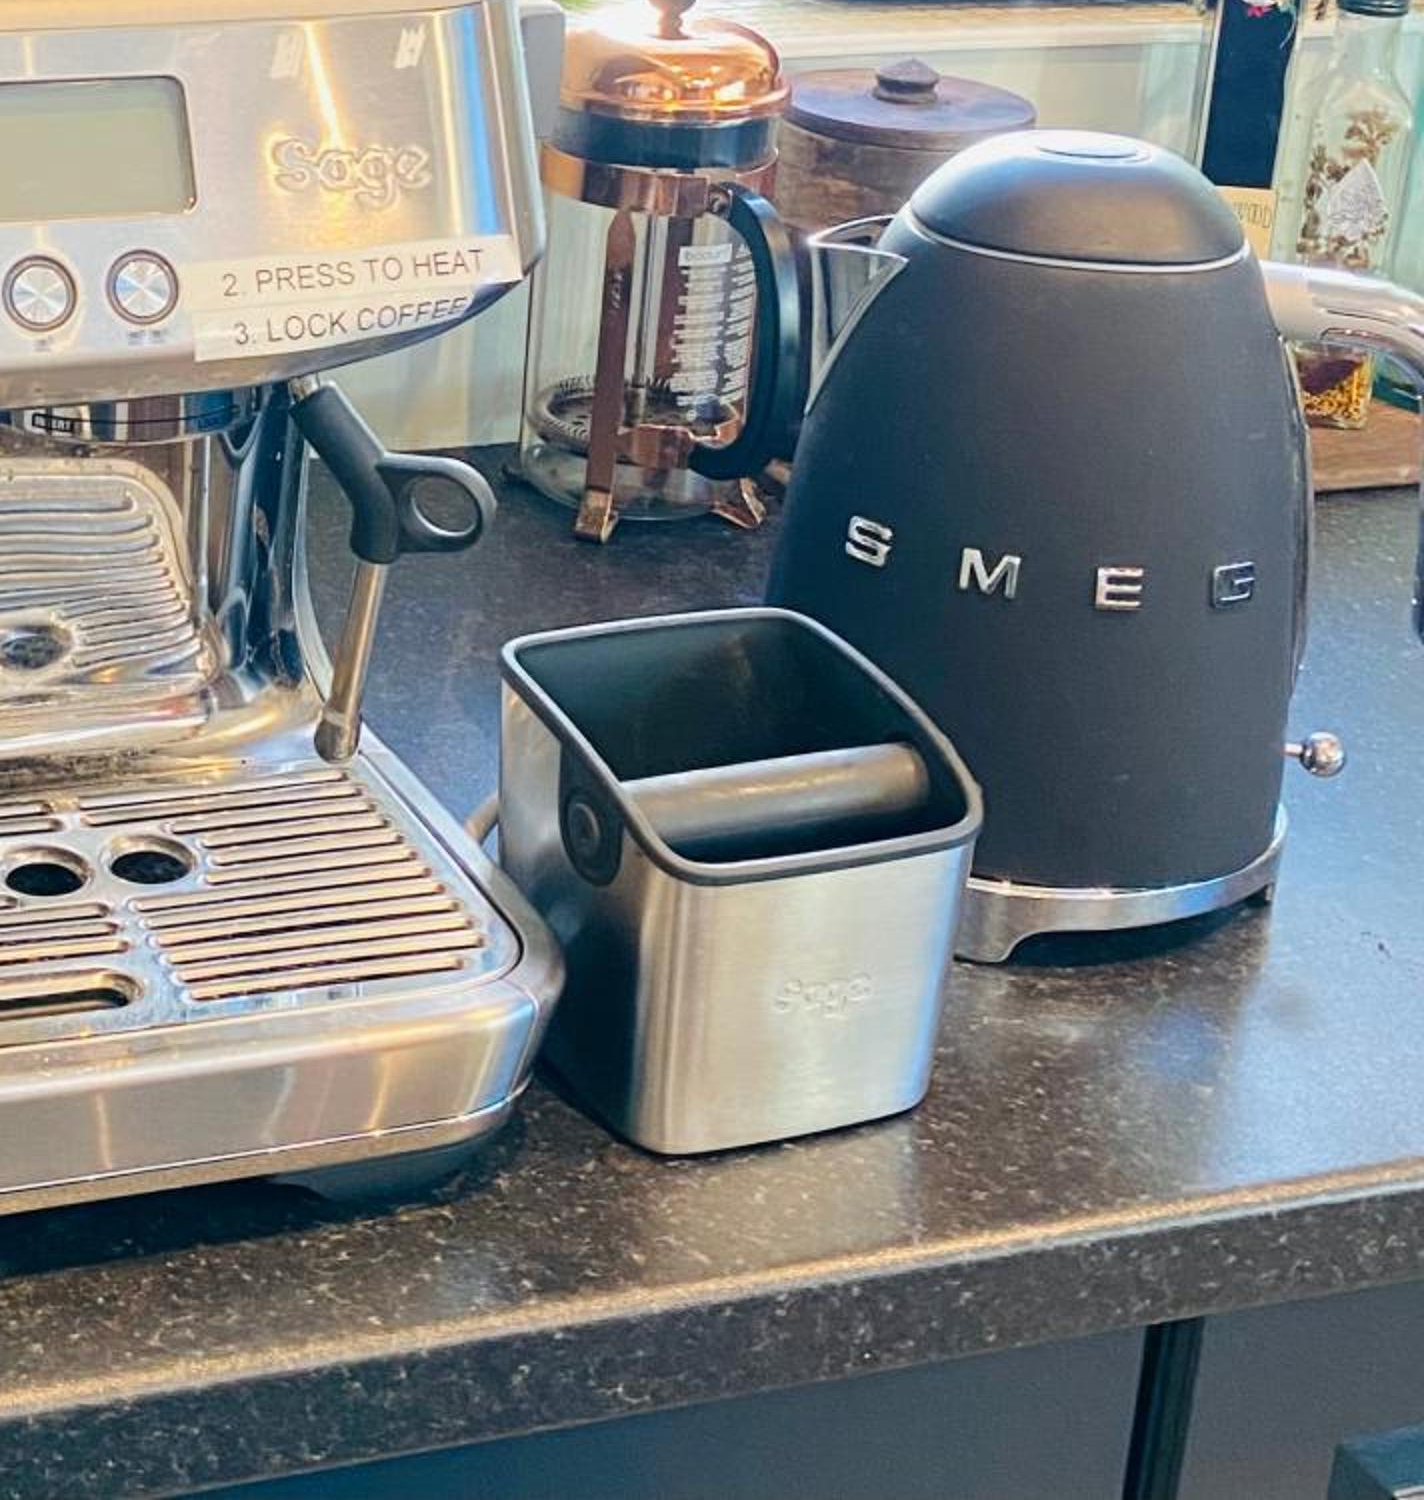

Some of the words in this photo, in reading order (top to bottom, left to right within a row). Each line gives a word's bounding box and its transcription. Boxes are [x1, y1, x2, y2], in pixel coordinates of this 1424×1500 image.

[268, 133, 433, 210] Sage
[222, 273, 247, 297] 2.
[255, 261, 355, 293] PRESS
[363, 257, 403, 283] TO
[413, 249, 484, 277] HEAT
[234, 322, 257, 345] 3.
[267, 312, 348, 342] LOCK
[357, 297, 468, 332] COFFEE
[845, 515, 1256, 611] SMEG
